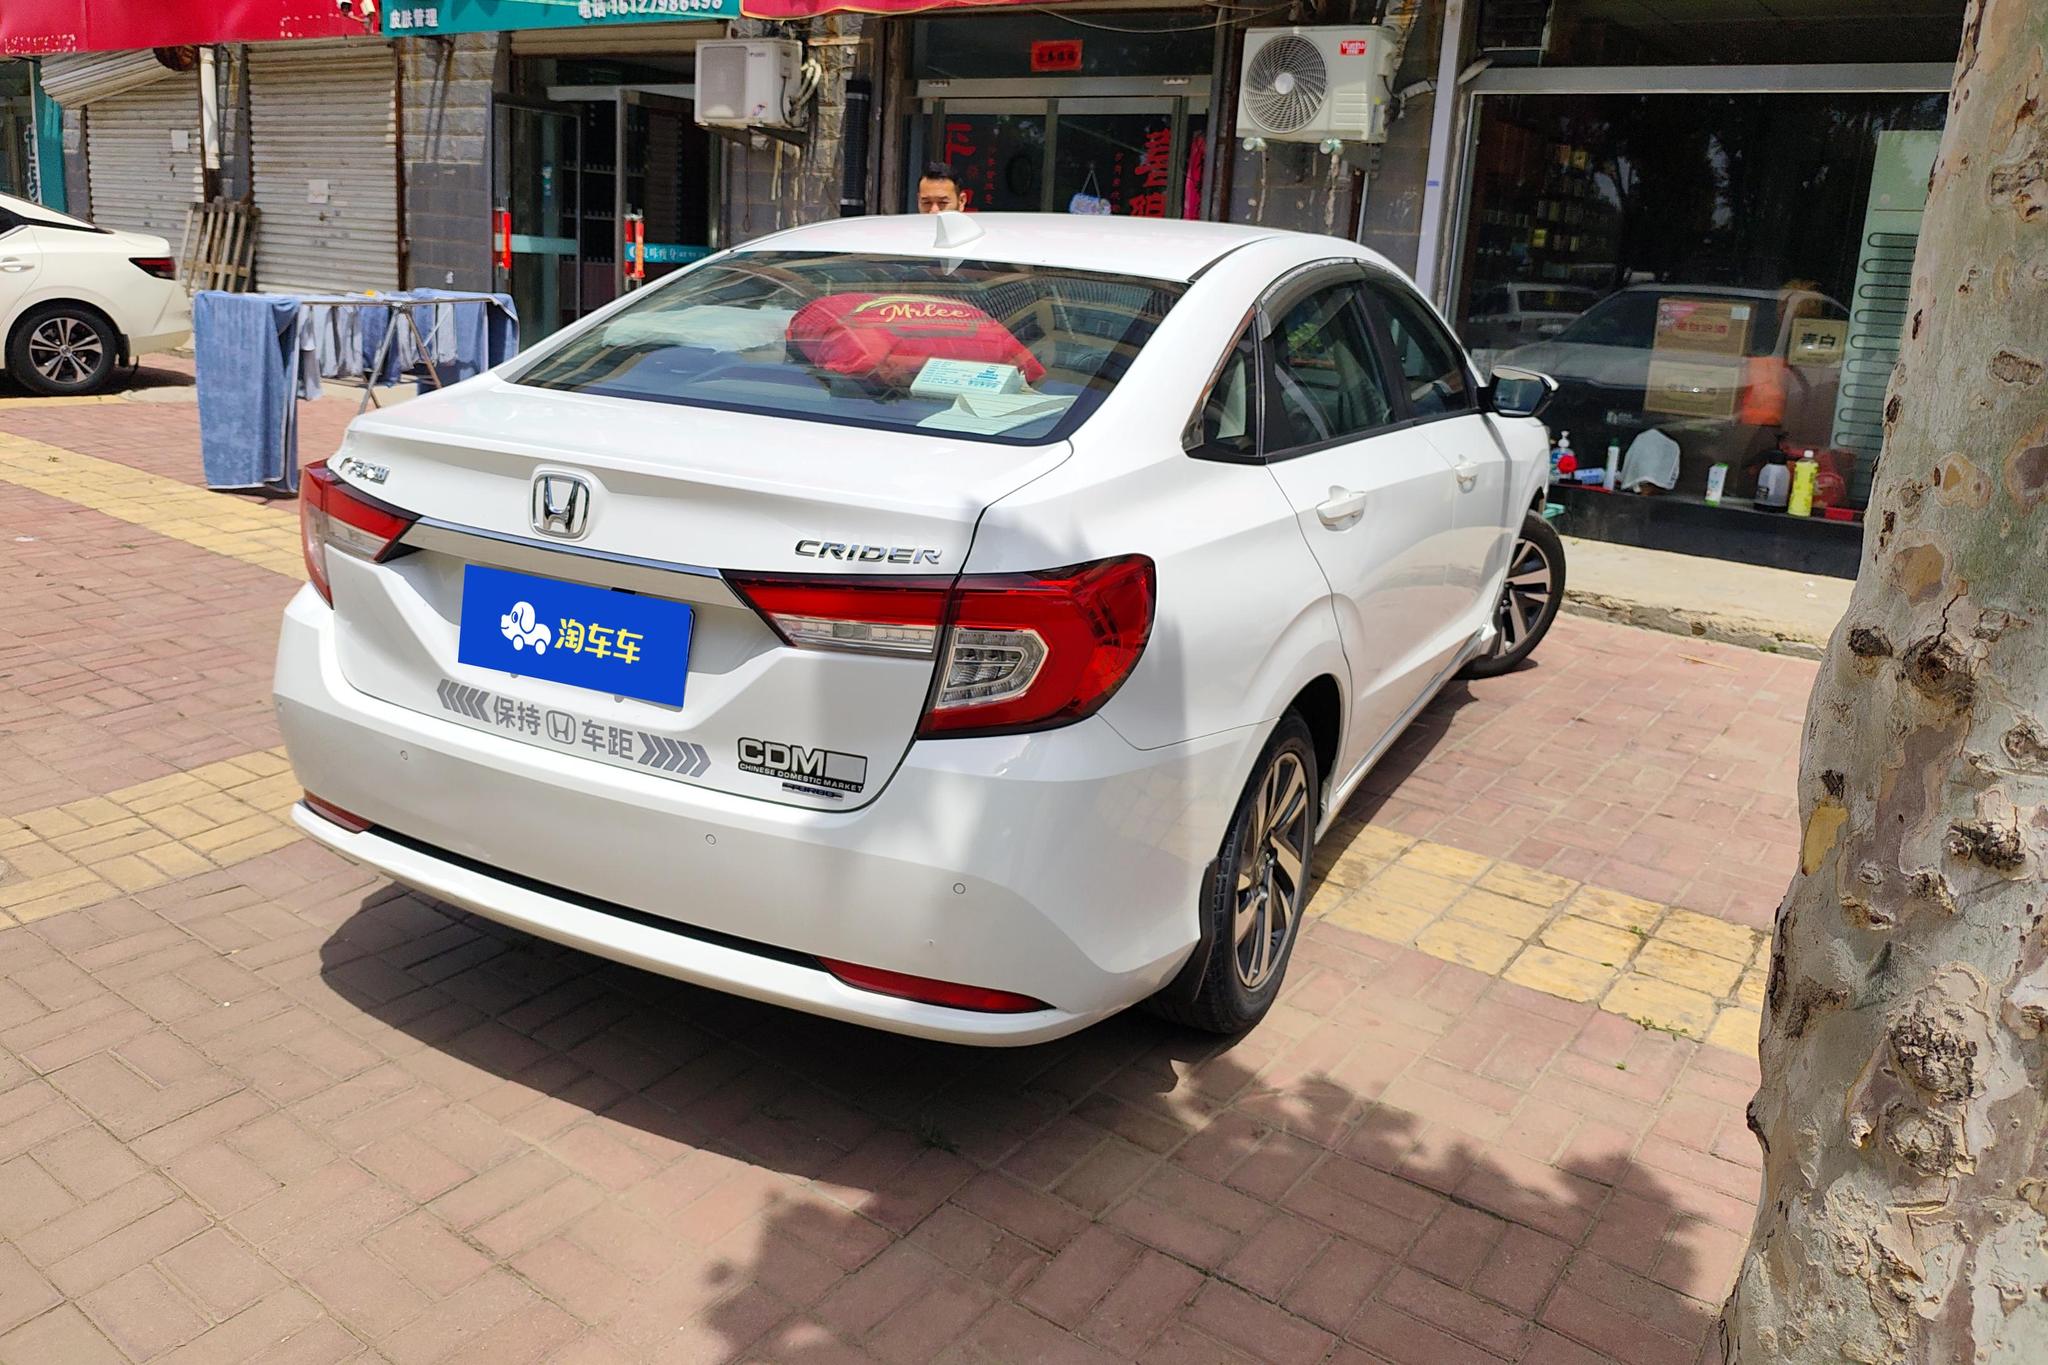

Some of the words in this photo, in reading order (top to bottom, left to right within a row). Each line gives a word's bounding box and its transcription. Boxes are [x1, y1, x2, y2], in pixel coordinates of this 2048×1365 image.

[389, 8, 439, 29] 皮肤管理
[795, 539, 942, 565] CRIDER
[493, 695, 541, 736] 保持
[581, 720, 634, 761] 车距
[739, 738, 824, 777] CDM
[739, 762, 776, 776] CHINESE
[777, 771, 822, 785] DOMESTIC
[823, 778, 863, 792] MARKET
